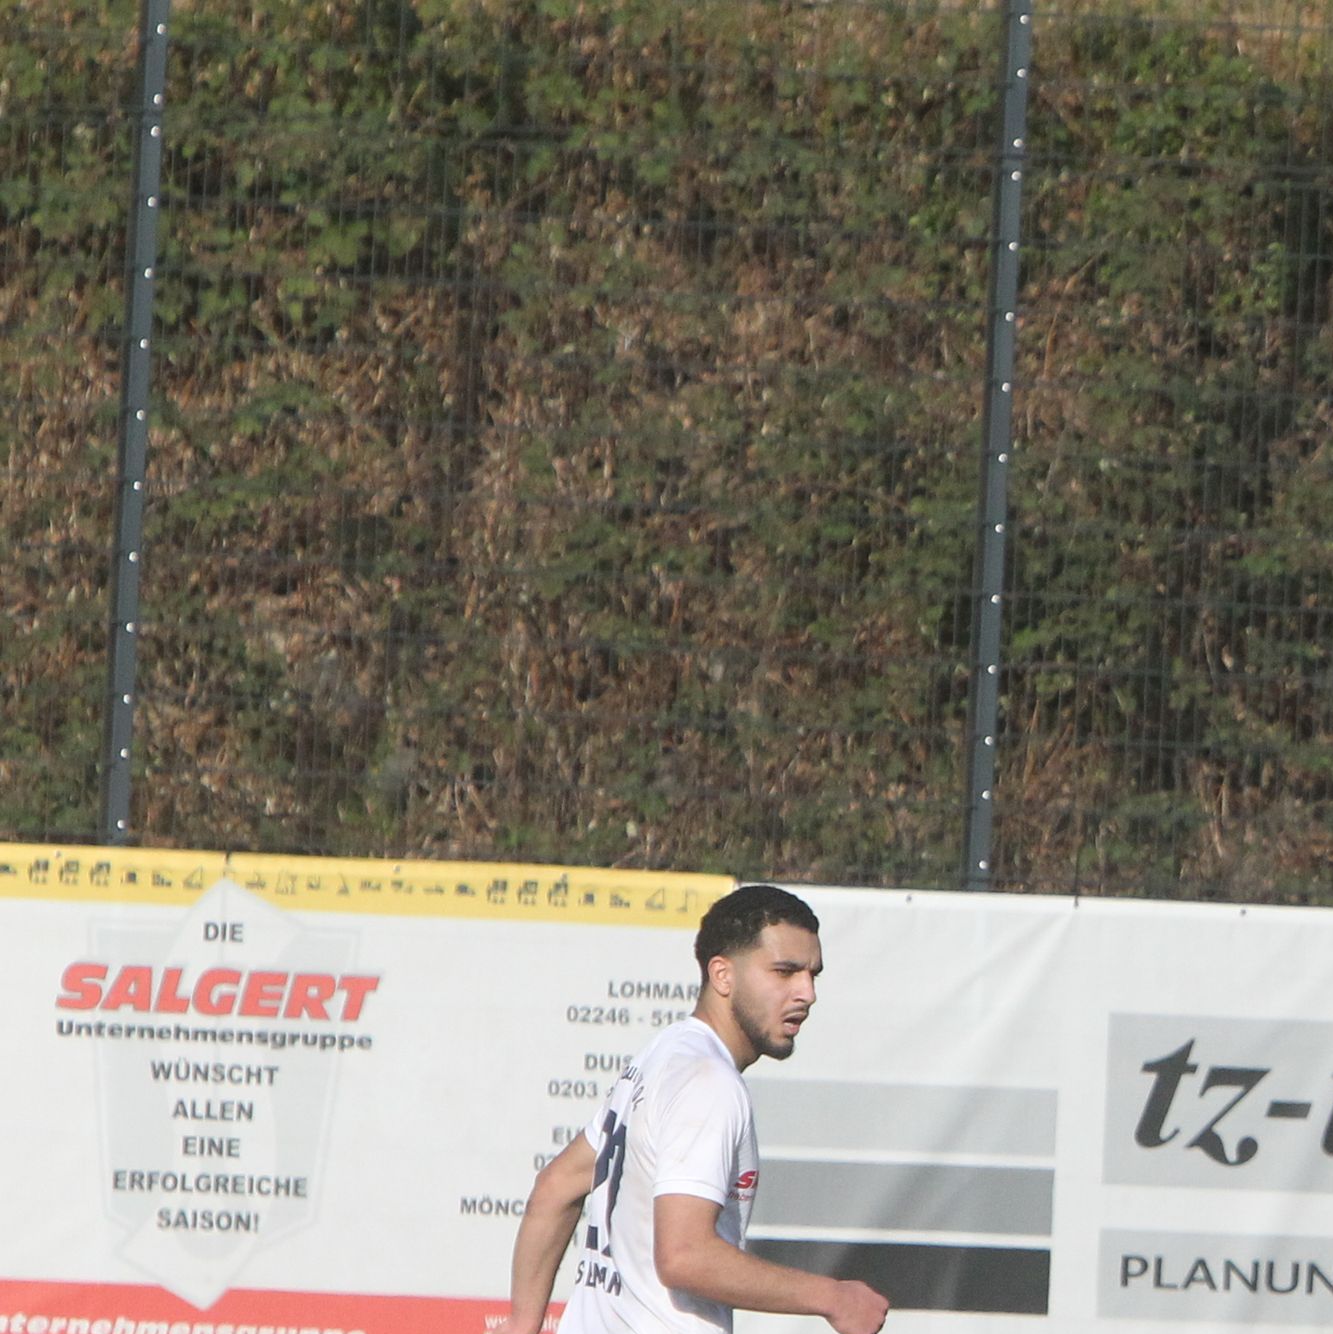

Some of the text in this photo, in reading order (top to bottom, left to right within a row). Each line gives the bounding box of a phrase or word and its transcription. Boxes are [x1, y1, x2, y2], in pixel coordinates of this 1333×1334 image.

[203, 922, 244, 943] DIE
[55, 961, 381, 1022] SALGERT
[566, 1005, 630, 1026] 02246
[56, 1019, 373, 1050] Unternehmensgruppe
[150, 1057, 279, 1086] WÜNSCHT
[547, 1079, 598, 1099] 0203
[172, 1098, 254, 1123] ALLEN
[181, 1135, 241, 1159] EINE
[112, 1169, 308, 1199] ERFOLGREICHE
[157, 1207, 260, 1234] SAISON!
